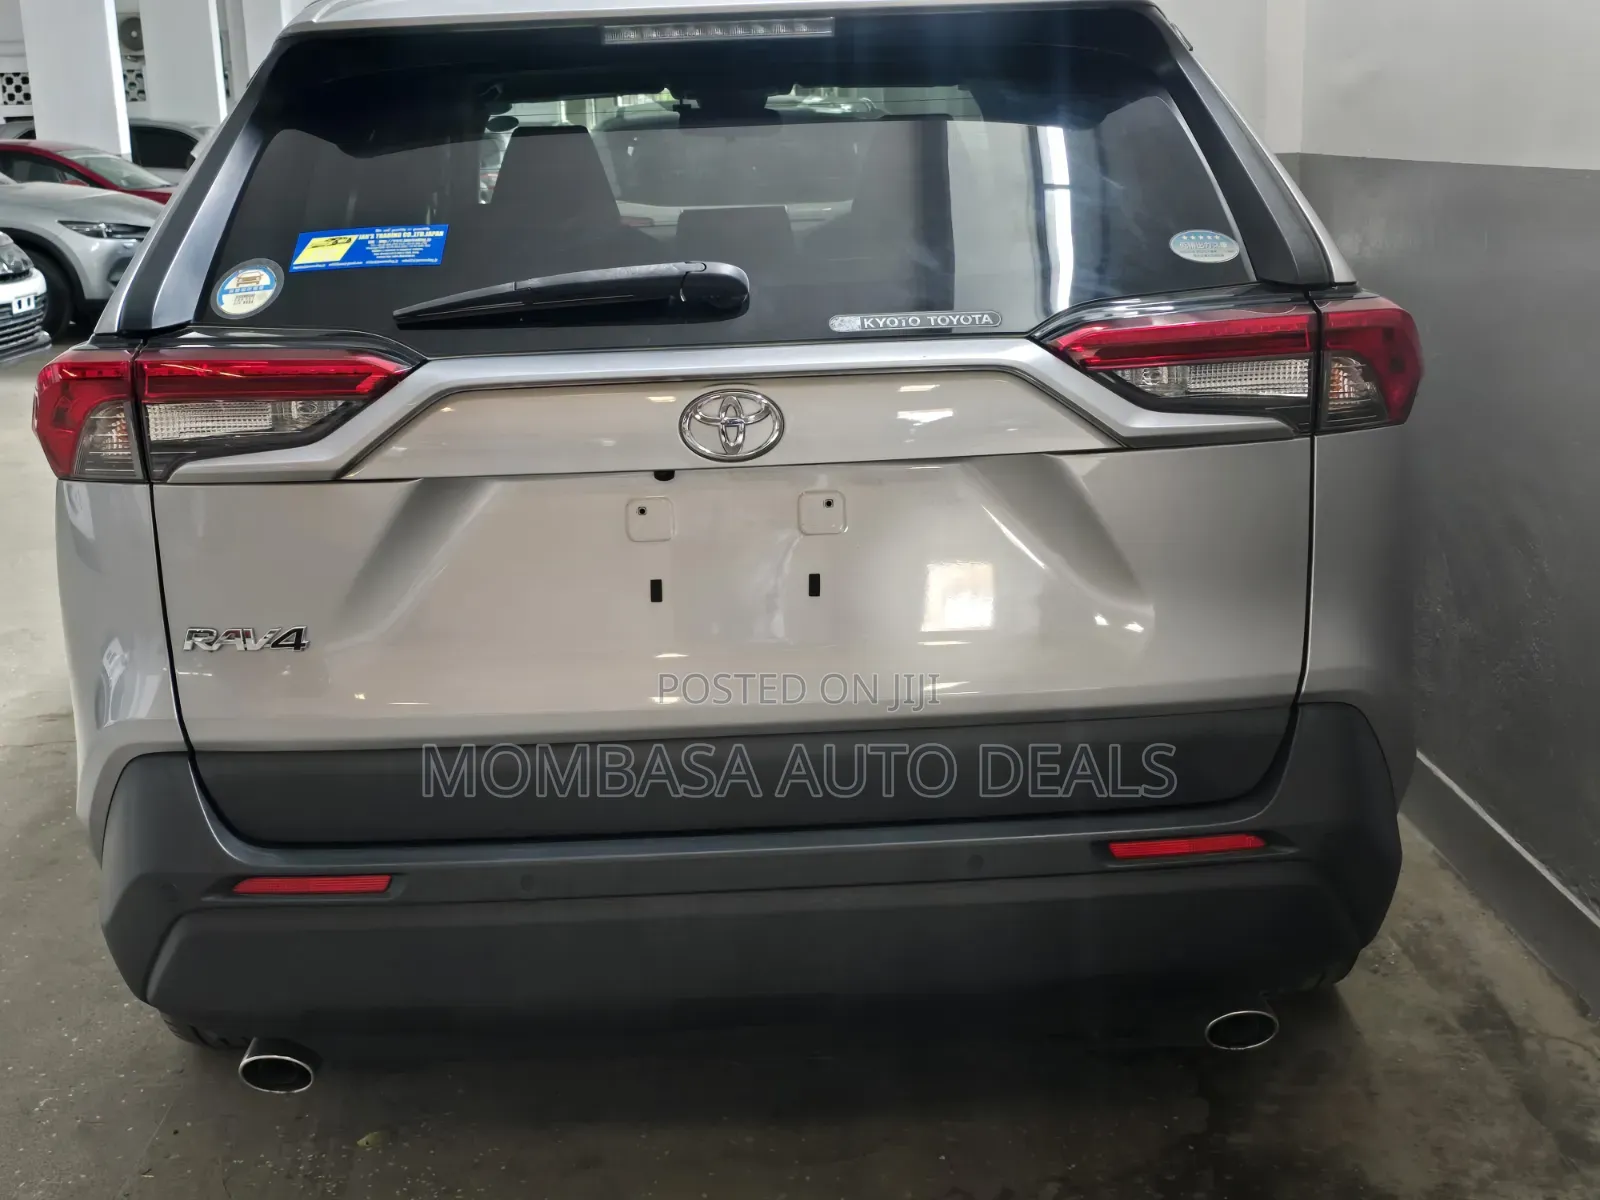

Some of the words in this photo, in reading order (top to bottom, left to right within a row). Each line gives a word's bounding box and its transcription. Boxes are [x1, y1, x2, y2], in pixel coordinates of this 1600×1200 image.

[864, 316, 921, 328] KYOTO
[927, 314, 994, 326] TOYOTA
[183, 626, 309, 652] RAV4
